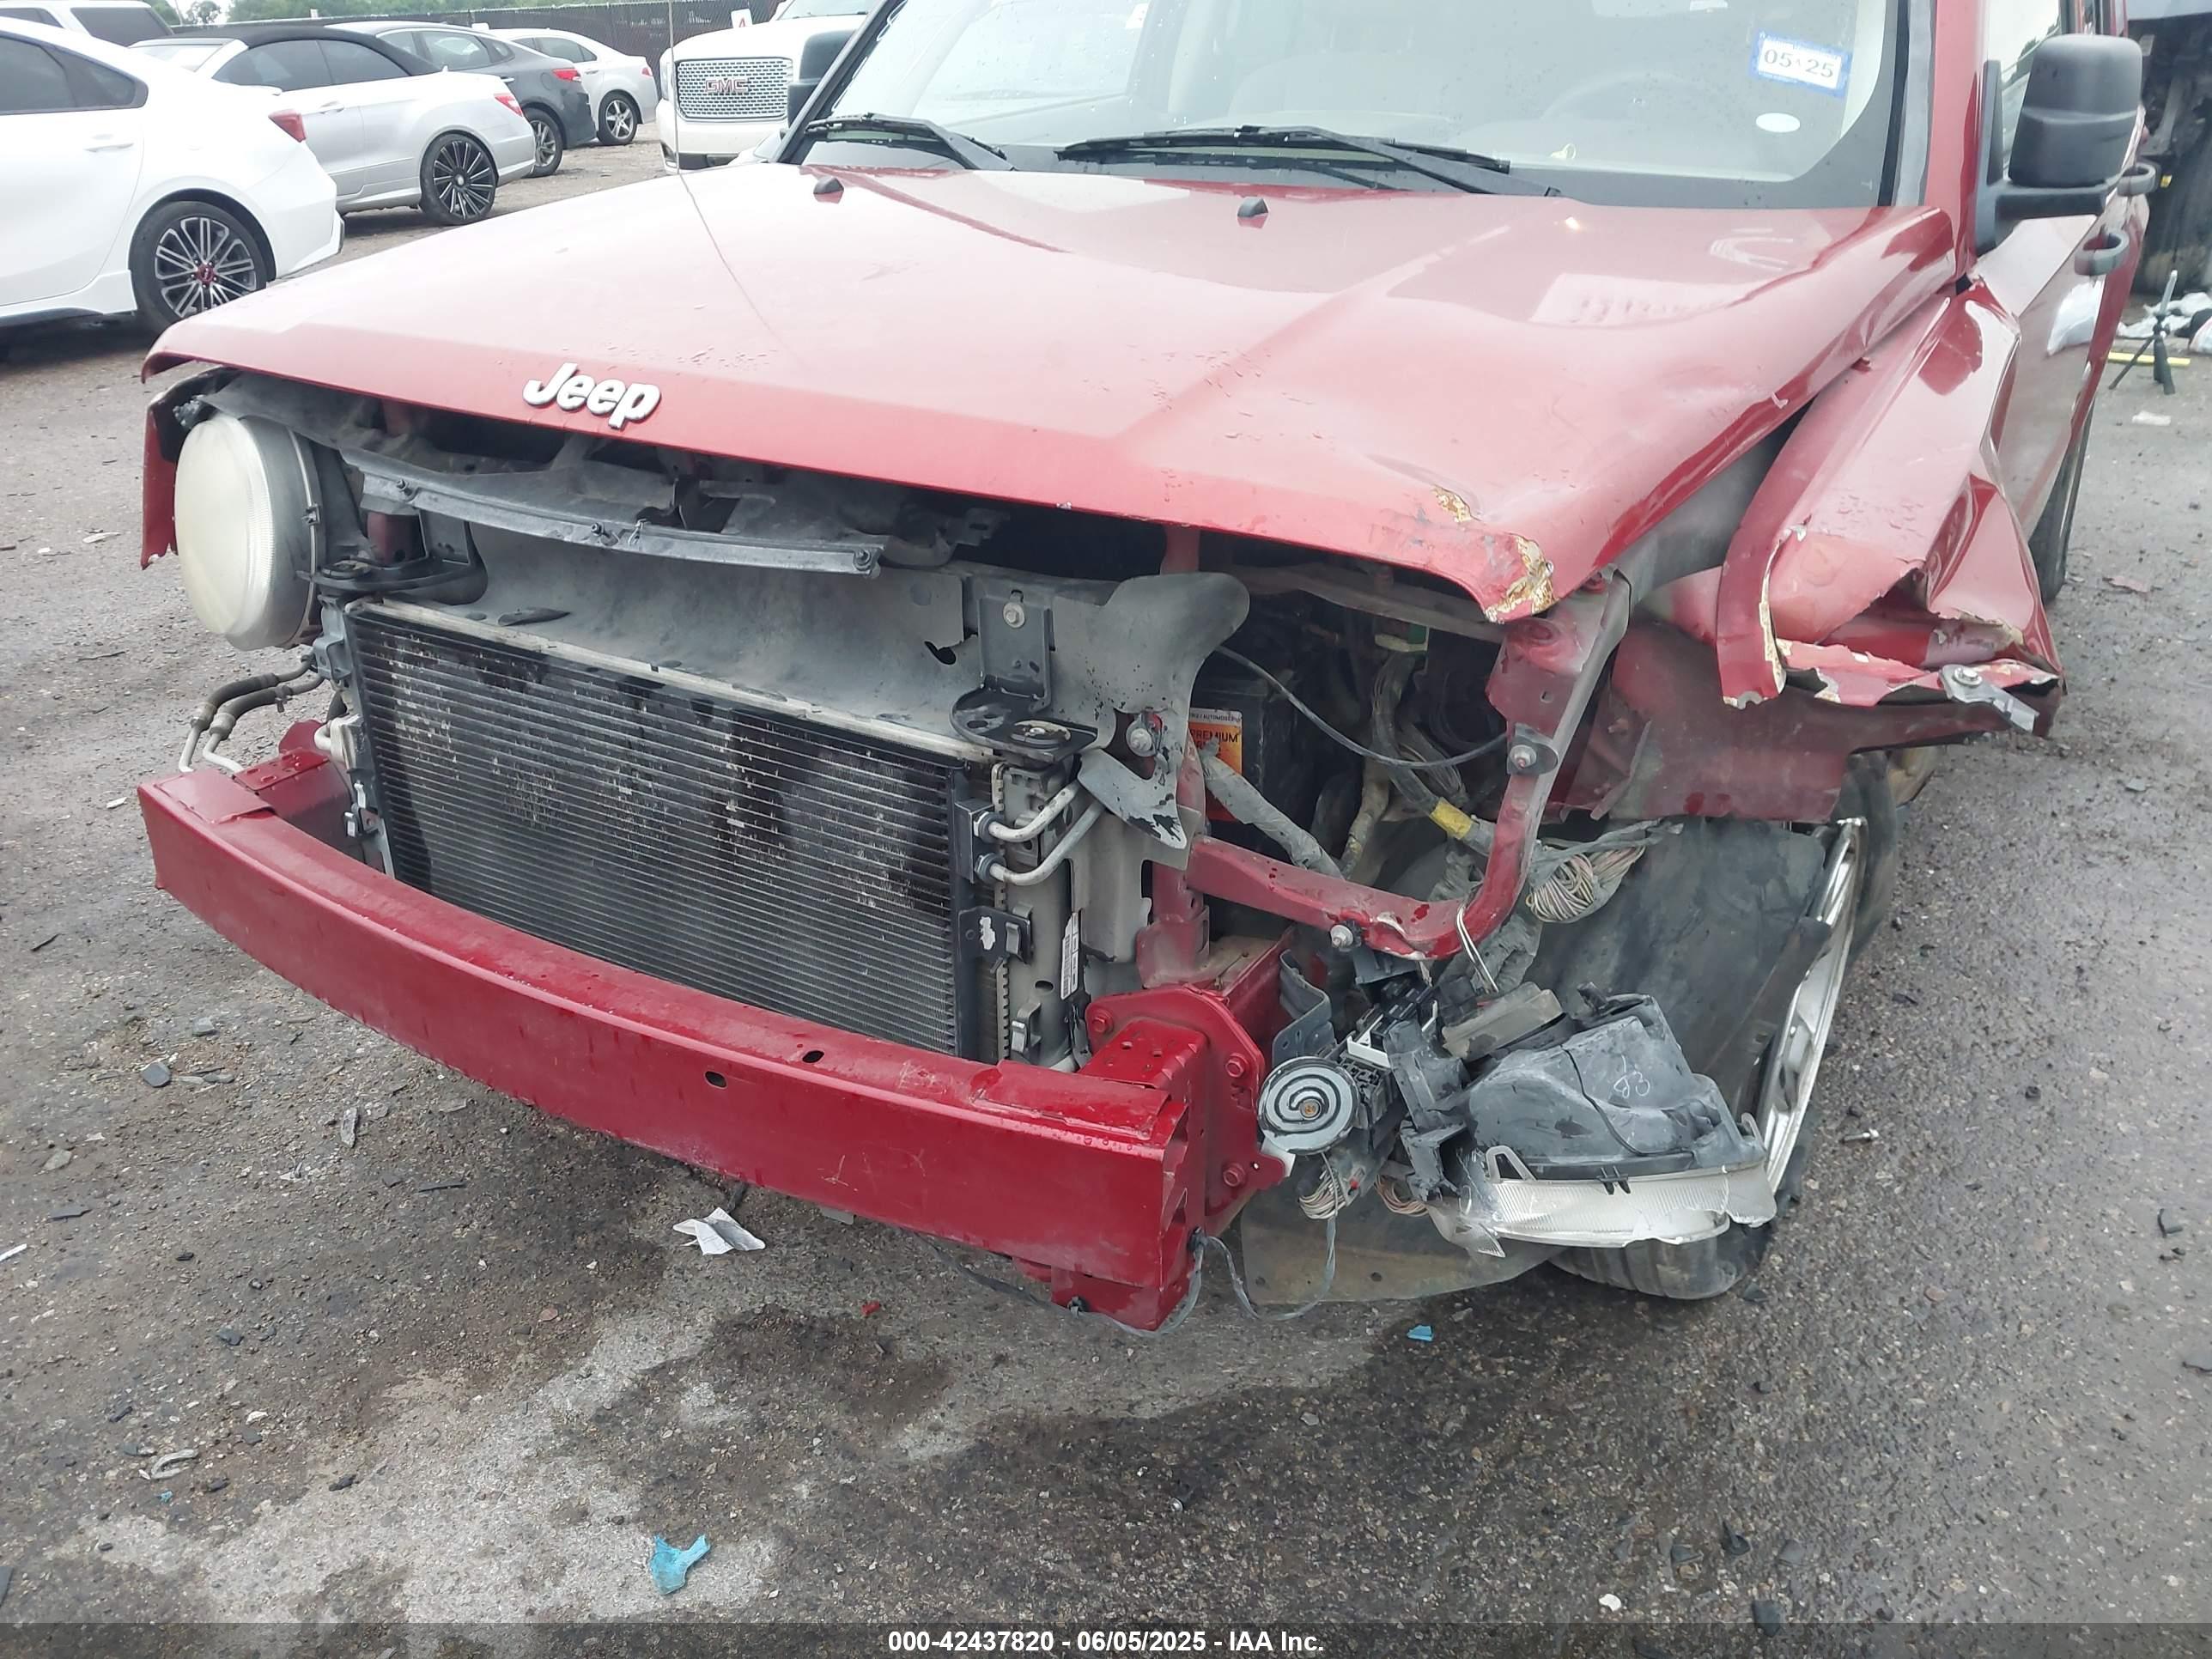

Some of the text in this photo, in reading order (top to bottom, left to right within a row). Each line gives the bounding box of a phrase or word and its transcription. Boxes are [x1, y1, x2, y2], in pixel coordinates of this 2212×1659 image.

[1764, 49, 1834, 78] 05 25
[706, 78, 749, 94] GMC
[522, 362, 661, 430] Jeep
[1190, 729, 1239, 742] PREMIUM
